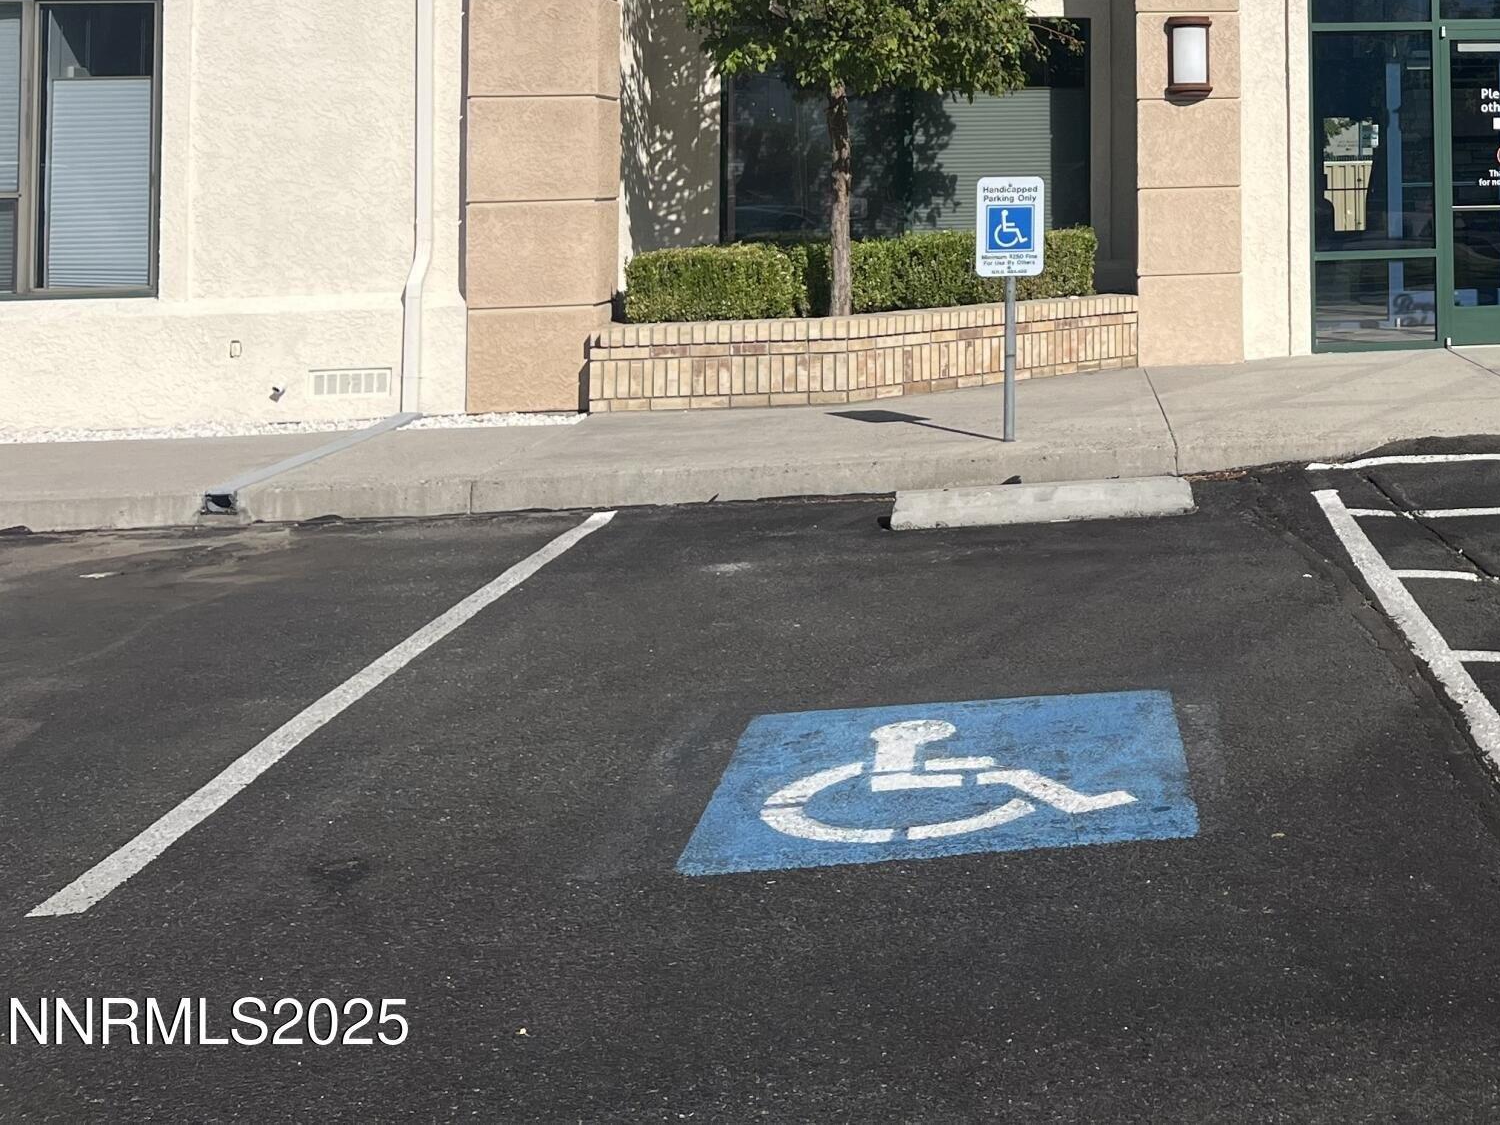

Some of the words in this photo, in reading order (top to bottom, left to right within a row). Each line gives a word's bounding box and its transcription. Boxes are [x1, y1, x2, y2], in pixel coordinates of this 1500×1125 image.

[1479, 178, 1490, 186] for
[983, 185, 1038, 194] Handicapped
[983, 195, 1015, 203] Parking
[1018, 194, 1037, 202] Only
